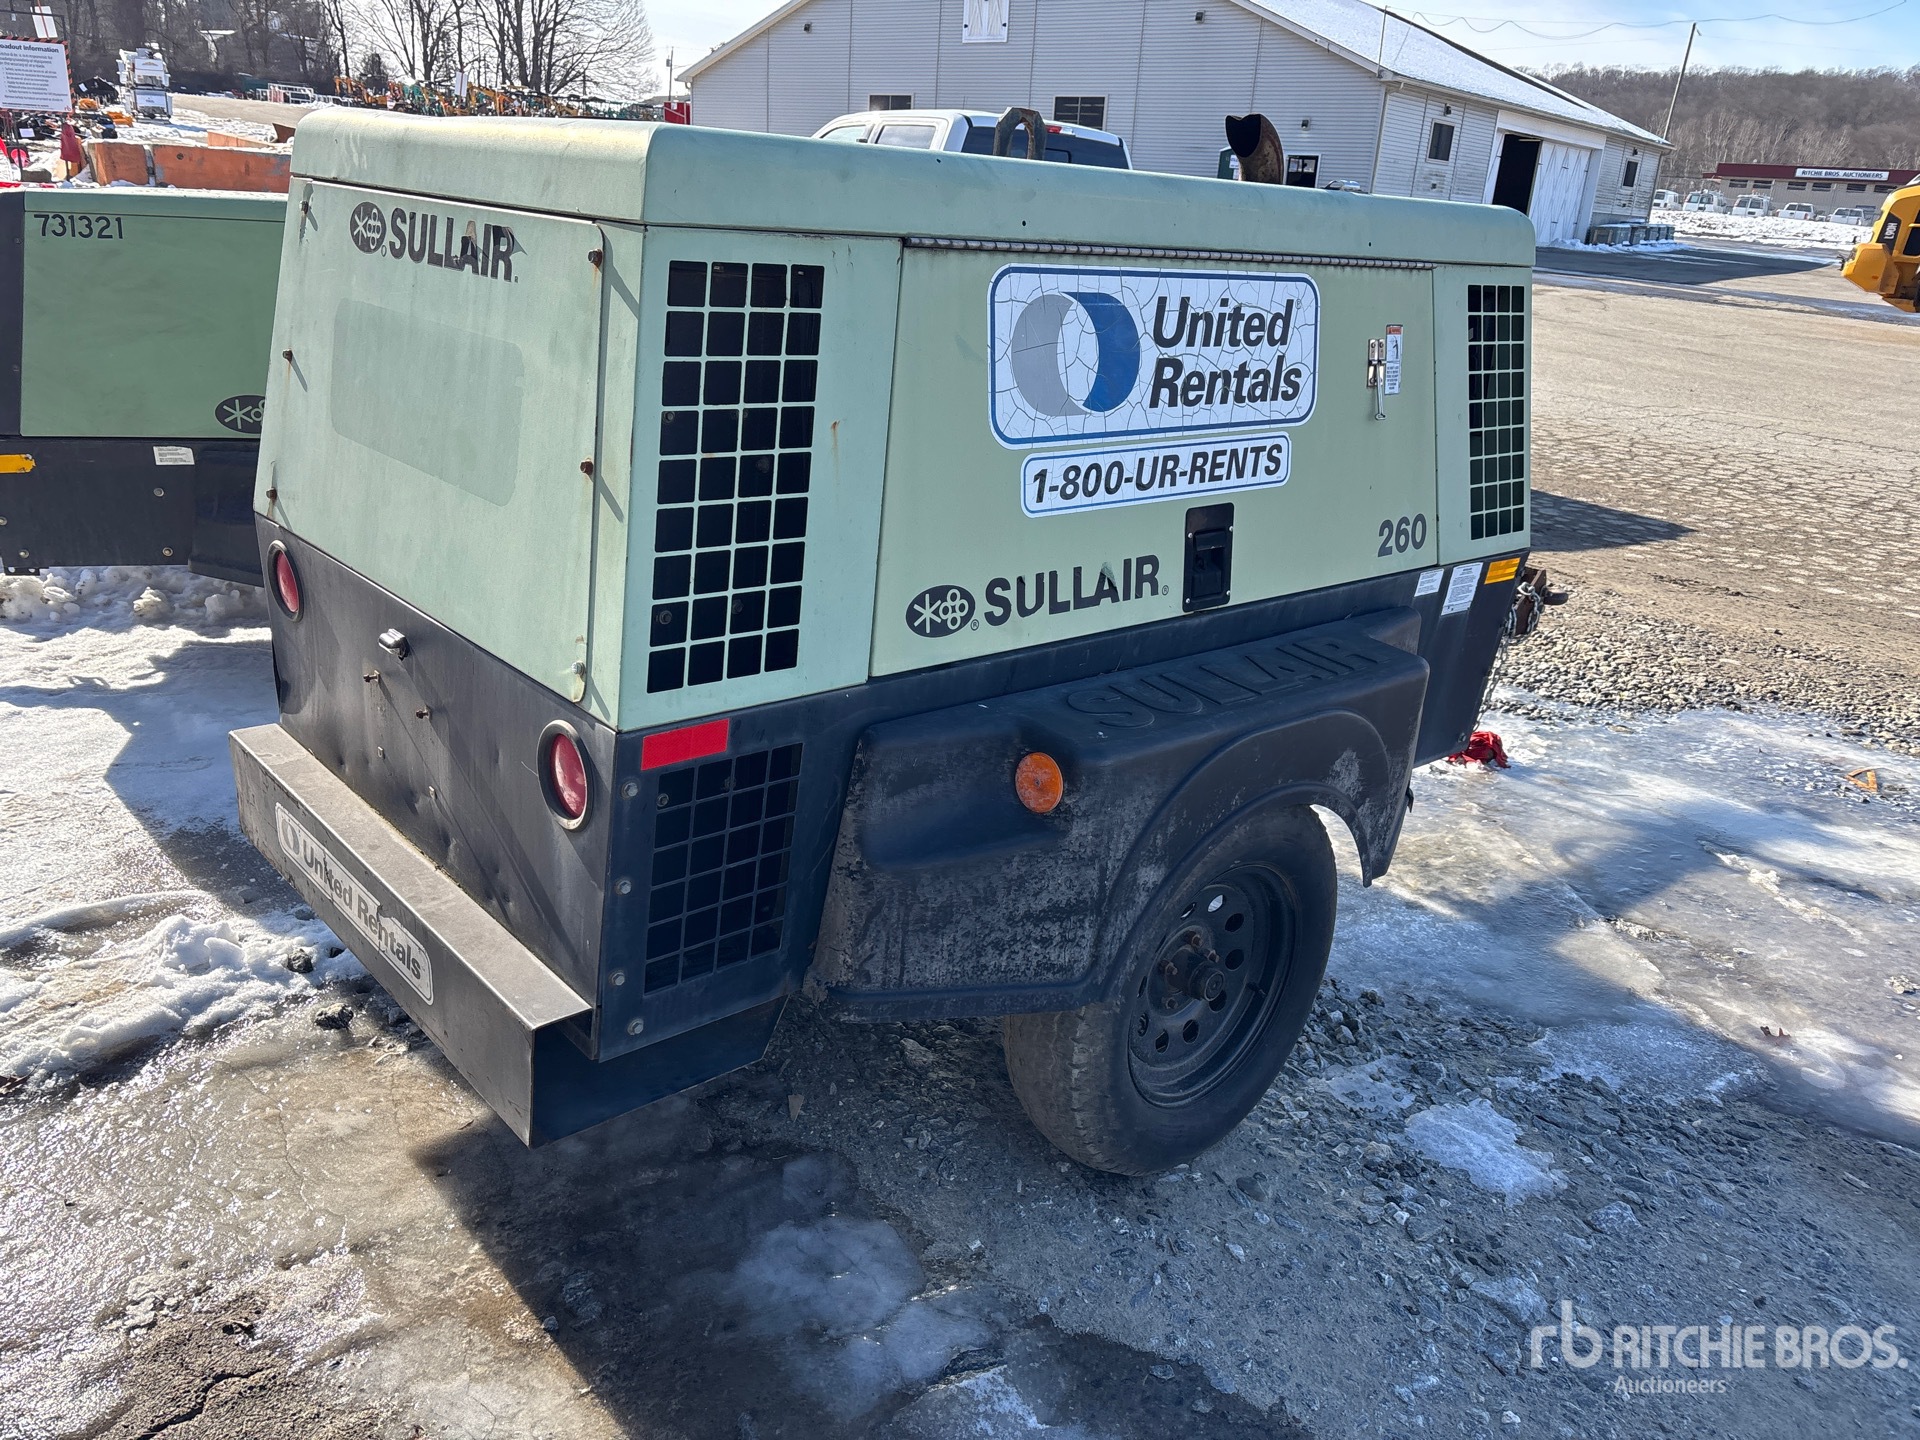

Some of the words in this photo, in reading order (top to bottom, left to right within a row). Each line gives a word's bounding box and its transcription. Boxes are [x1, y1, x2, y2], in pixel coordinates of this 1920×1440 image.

[23, 45, 59, 53] Information
[1842, 171, 1883, 179] AUCTIONEERS
[34, 213, 124, 240] 731321
[388, 207, 514, 283] SULLAIR
[1153, 296, 1295, 349] United
[1149, 355, 1302, 409] Rentals
[1032, 443, 1283, 504] 1-800-UR-RENTS
[1378, 513, 1427, 558] 260
[984, 554, 1160, 627] SULLAIR
[1066, 637, 1388, 728] SULLAIR
[303, 840, 353, 911] United
[357, 894, 422, 980] Rentals
